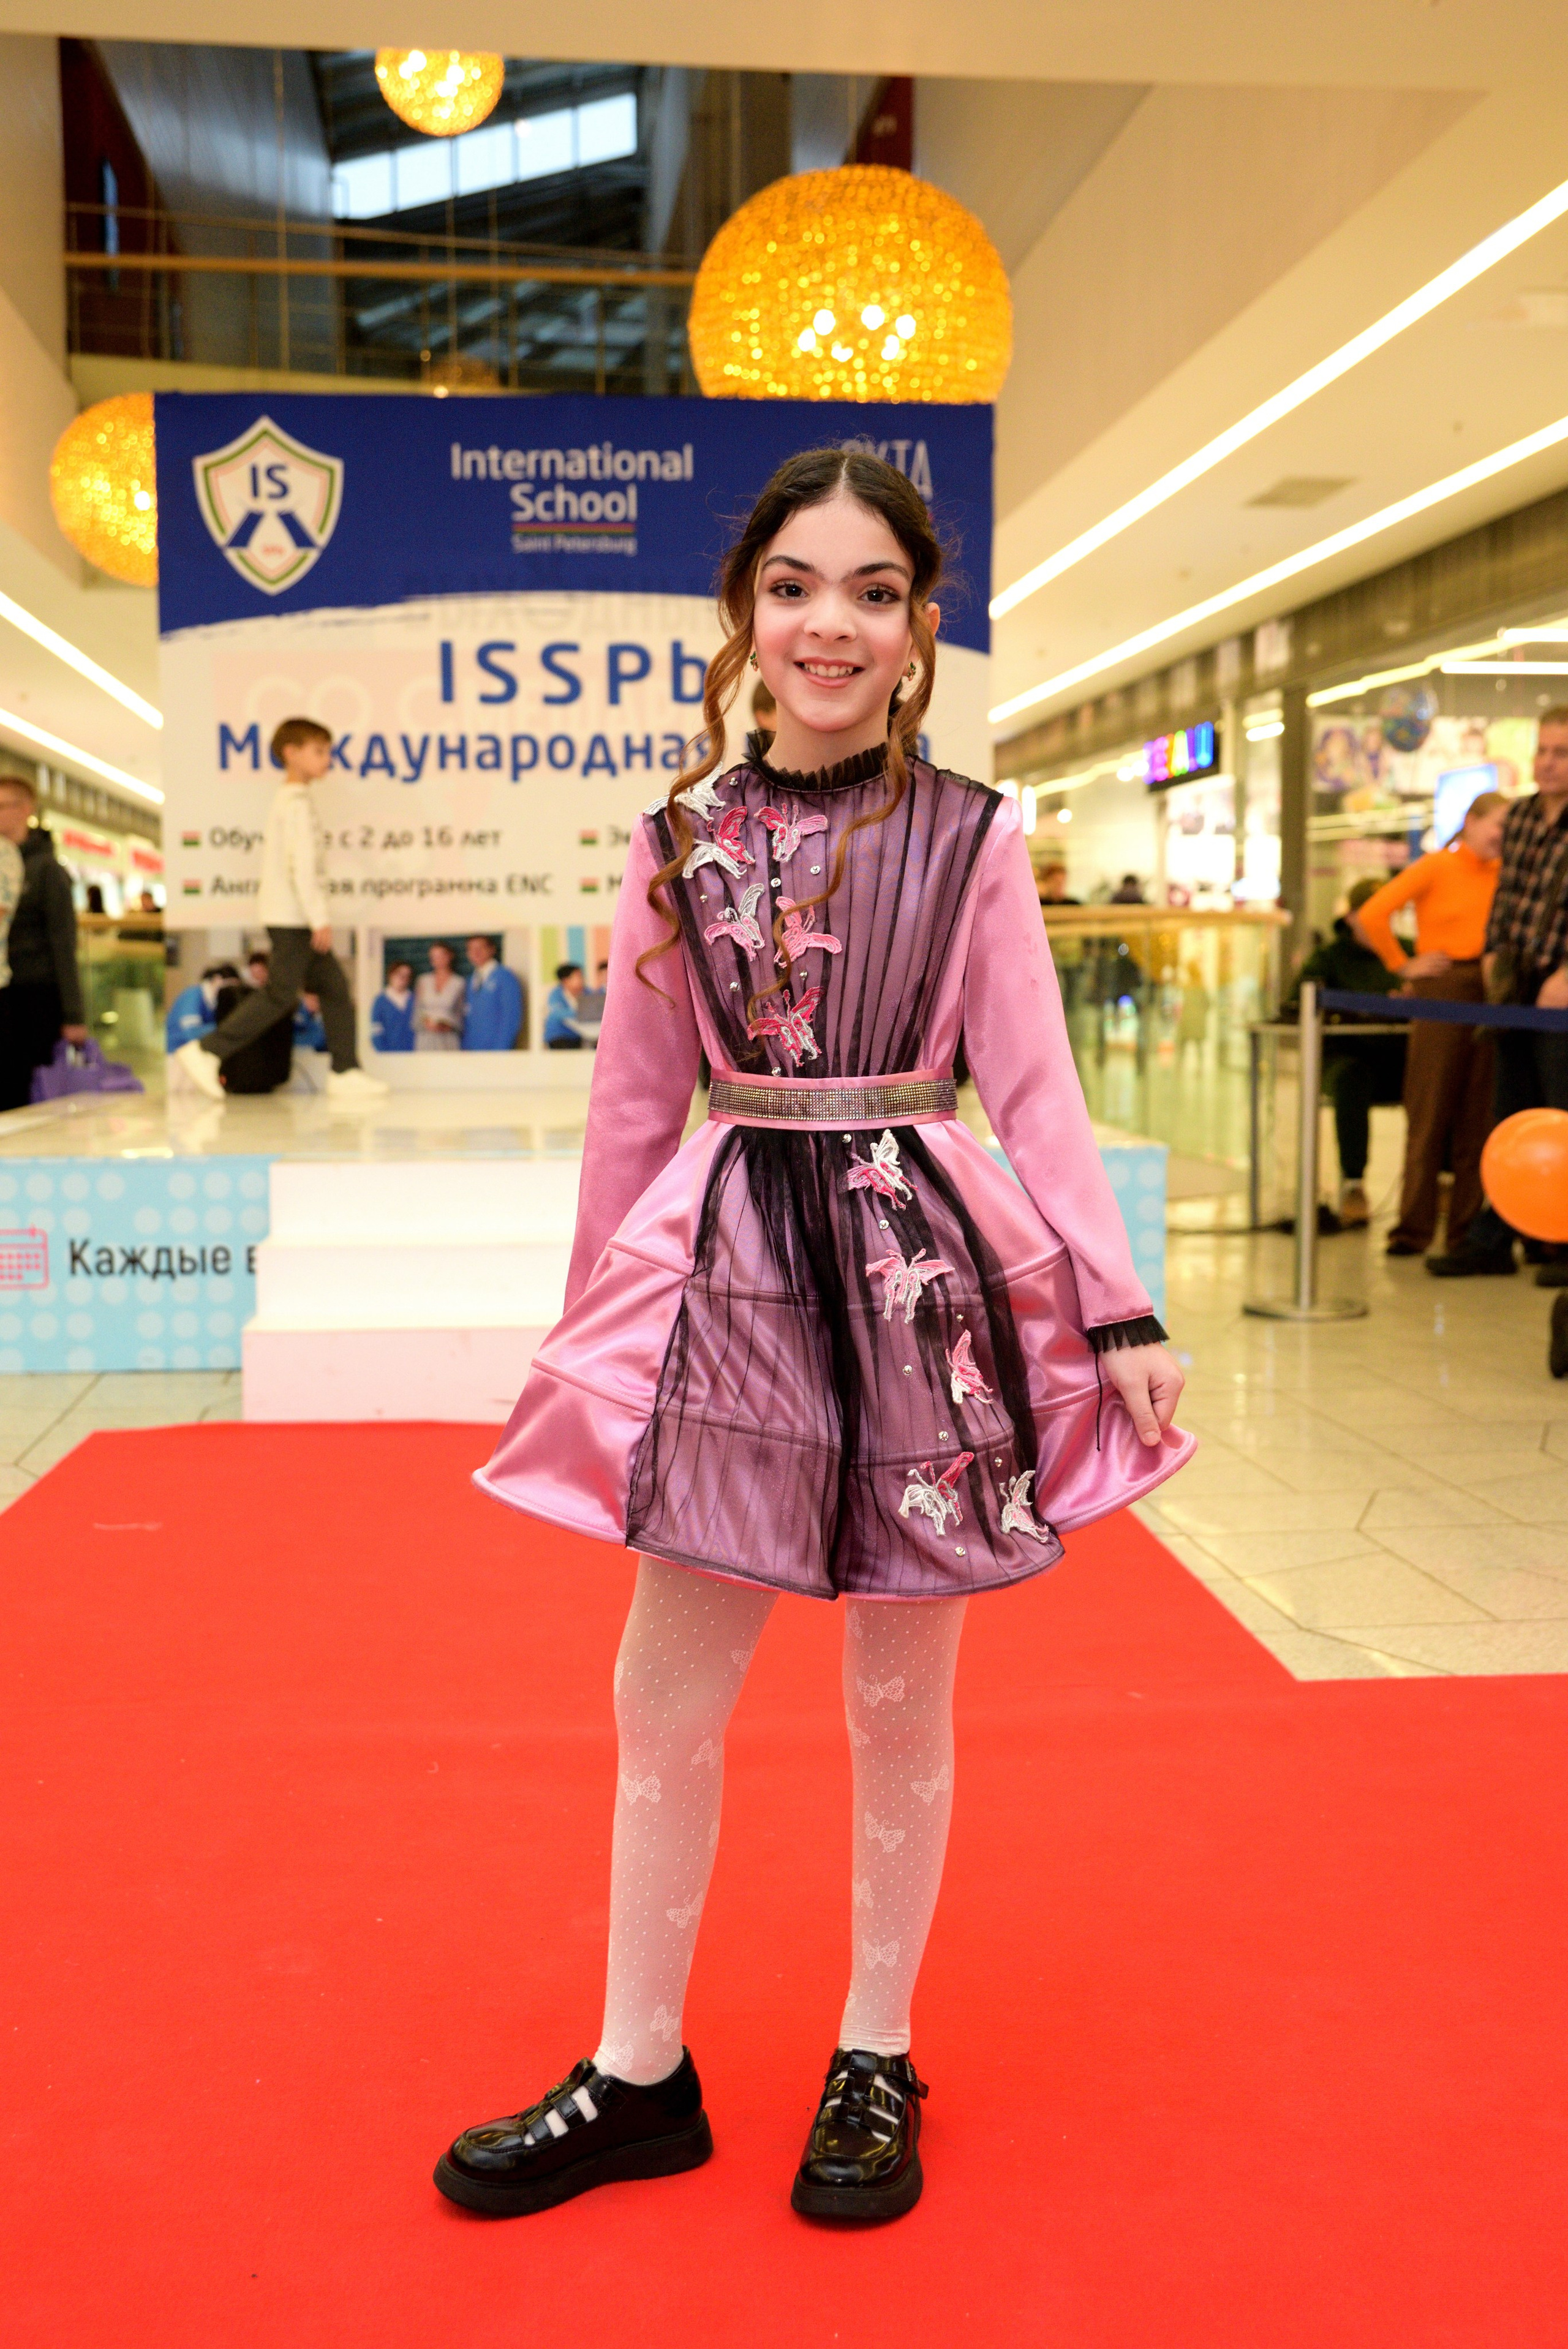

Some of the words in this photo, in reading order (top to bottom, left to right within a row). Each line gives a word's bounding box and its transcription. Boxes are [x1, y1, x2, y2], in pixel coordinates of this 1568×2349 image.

[451, 442, 693, 481] International
[249, 463, 290, 500] IS
[510, 483, 637, 522] School
[218, 722, 710, 783] Мдународна
[360, 826, 375, 848] 2
[382, 831, 413, 851] до
[423, 826, 453, 848] 16
[460, 830, 501, 848] лет
[69, 1238, 232, 1281] Каждые
